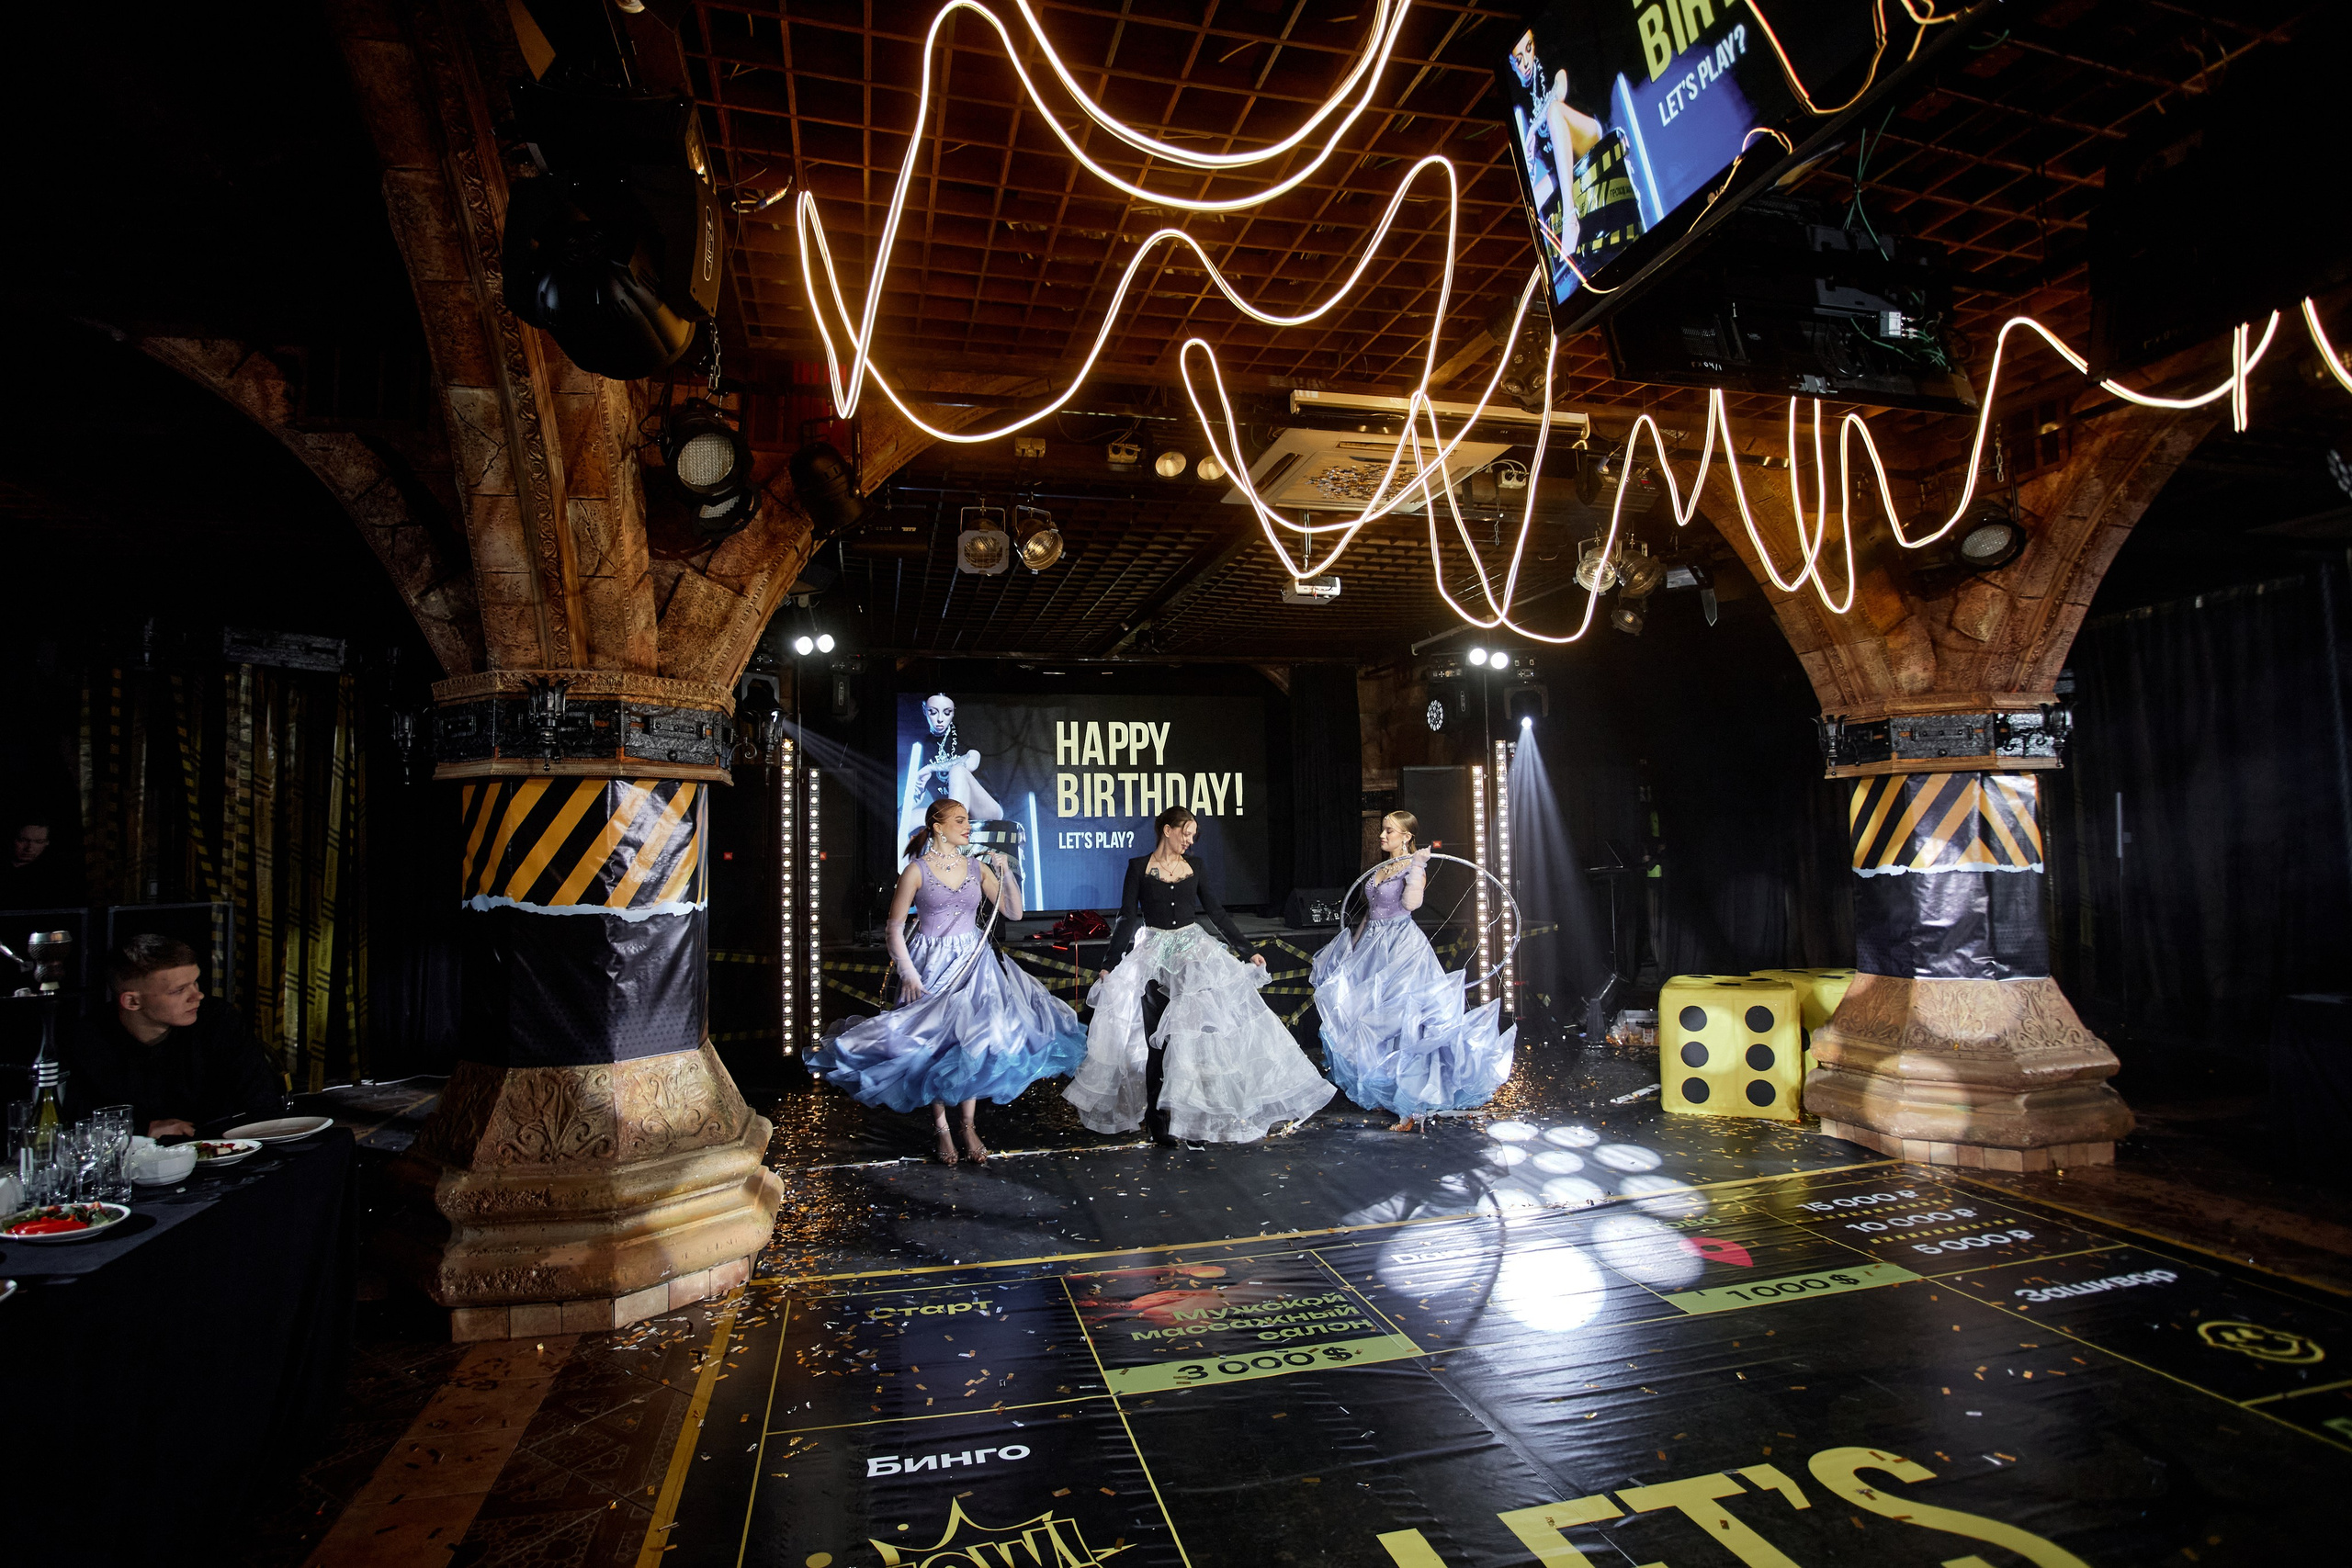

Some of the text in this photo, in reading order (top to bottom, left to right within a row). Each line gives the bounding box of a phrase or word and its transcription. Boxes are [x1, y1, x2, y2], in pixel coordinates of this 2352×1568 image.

[1637, 0, 1735, 83] BIR
[1658, 23, 1746, 127] LET'S PLAY?
[1057, 721, 1170, 766] HAPPY
[1057, 773, 1243, 818] BIRTHDAY!
[1058, 831, 1135, 850] LET'S PLAY?
[2014, 1269, 2178, 1302] Зашквар
[865, 1300, 993, 1320] Старт
[1130, 1304, 1360, 1341] массажный
[1172, 1292, 1348, 1322] Мужской
[1257, 1319, 1373, 1340] салон
[866, 1444, 1031, 1478] Бинго
